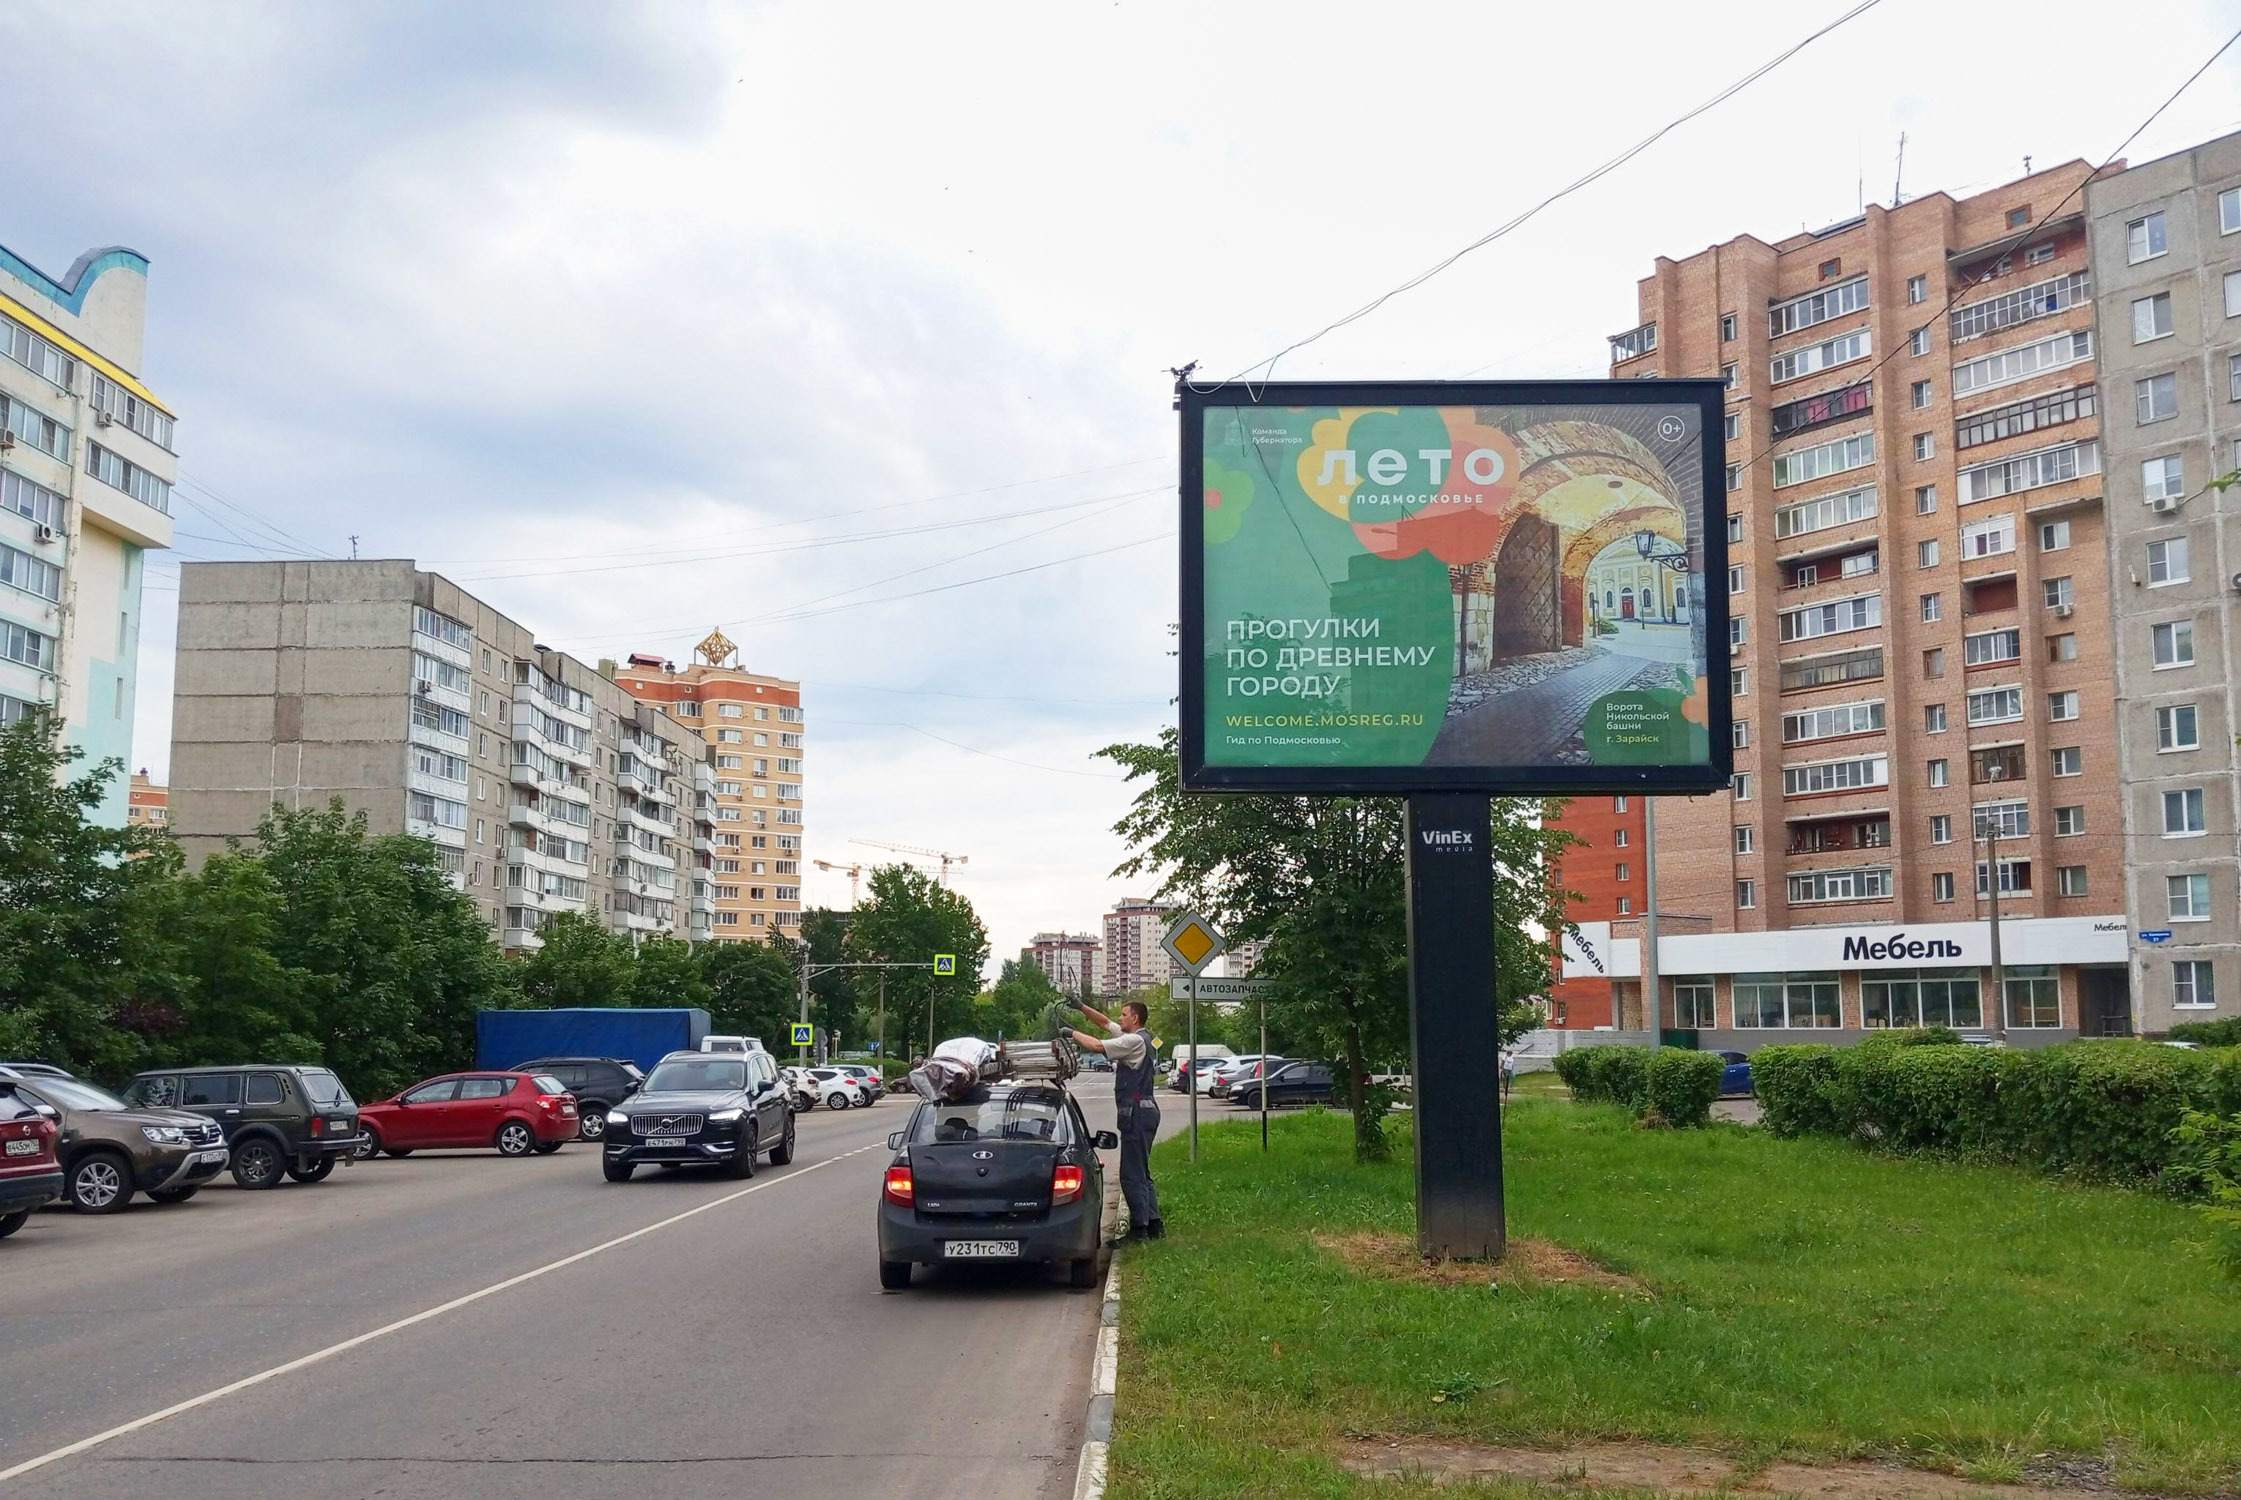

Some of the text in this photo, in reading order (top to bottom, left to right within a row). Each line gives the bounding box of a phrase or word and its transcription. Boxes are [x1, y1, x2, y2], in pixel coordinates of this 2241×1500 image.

[1662, 423, 1681, 435] 0+
[1252, 437, 1303, 445] Губернатора
[1356, 494, 1484, 505] ПОДМОСКОВЬЕ
[1226, 618, 1380, 640] ПРОГУЛКИ
[1227, 646, 1436, 671] ПО ДРЕВНЕМУ
[1227, 675, 1341, 699] ГОРОДУ
[1606, 703, 1643, 712] Ворота
[1226, 714, 1424, 727] WELCOME.MOSREG.RU
[1606, 712, 1670, 721] Никольской
[1606, 721, 1642, 730] башни
[1226, 736, 1246, 746] Гид
[1264, 736, 1341, 746] Подмосковью
[1616, 734, 1659, 744] Зарайск
[1422, 830, 1473, 844] VinEx
[1843, 933, 1963, 960] Мебель
